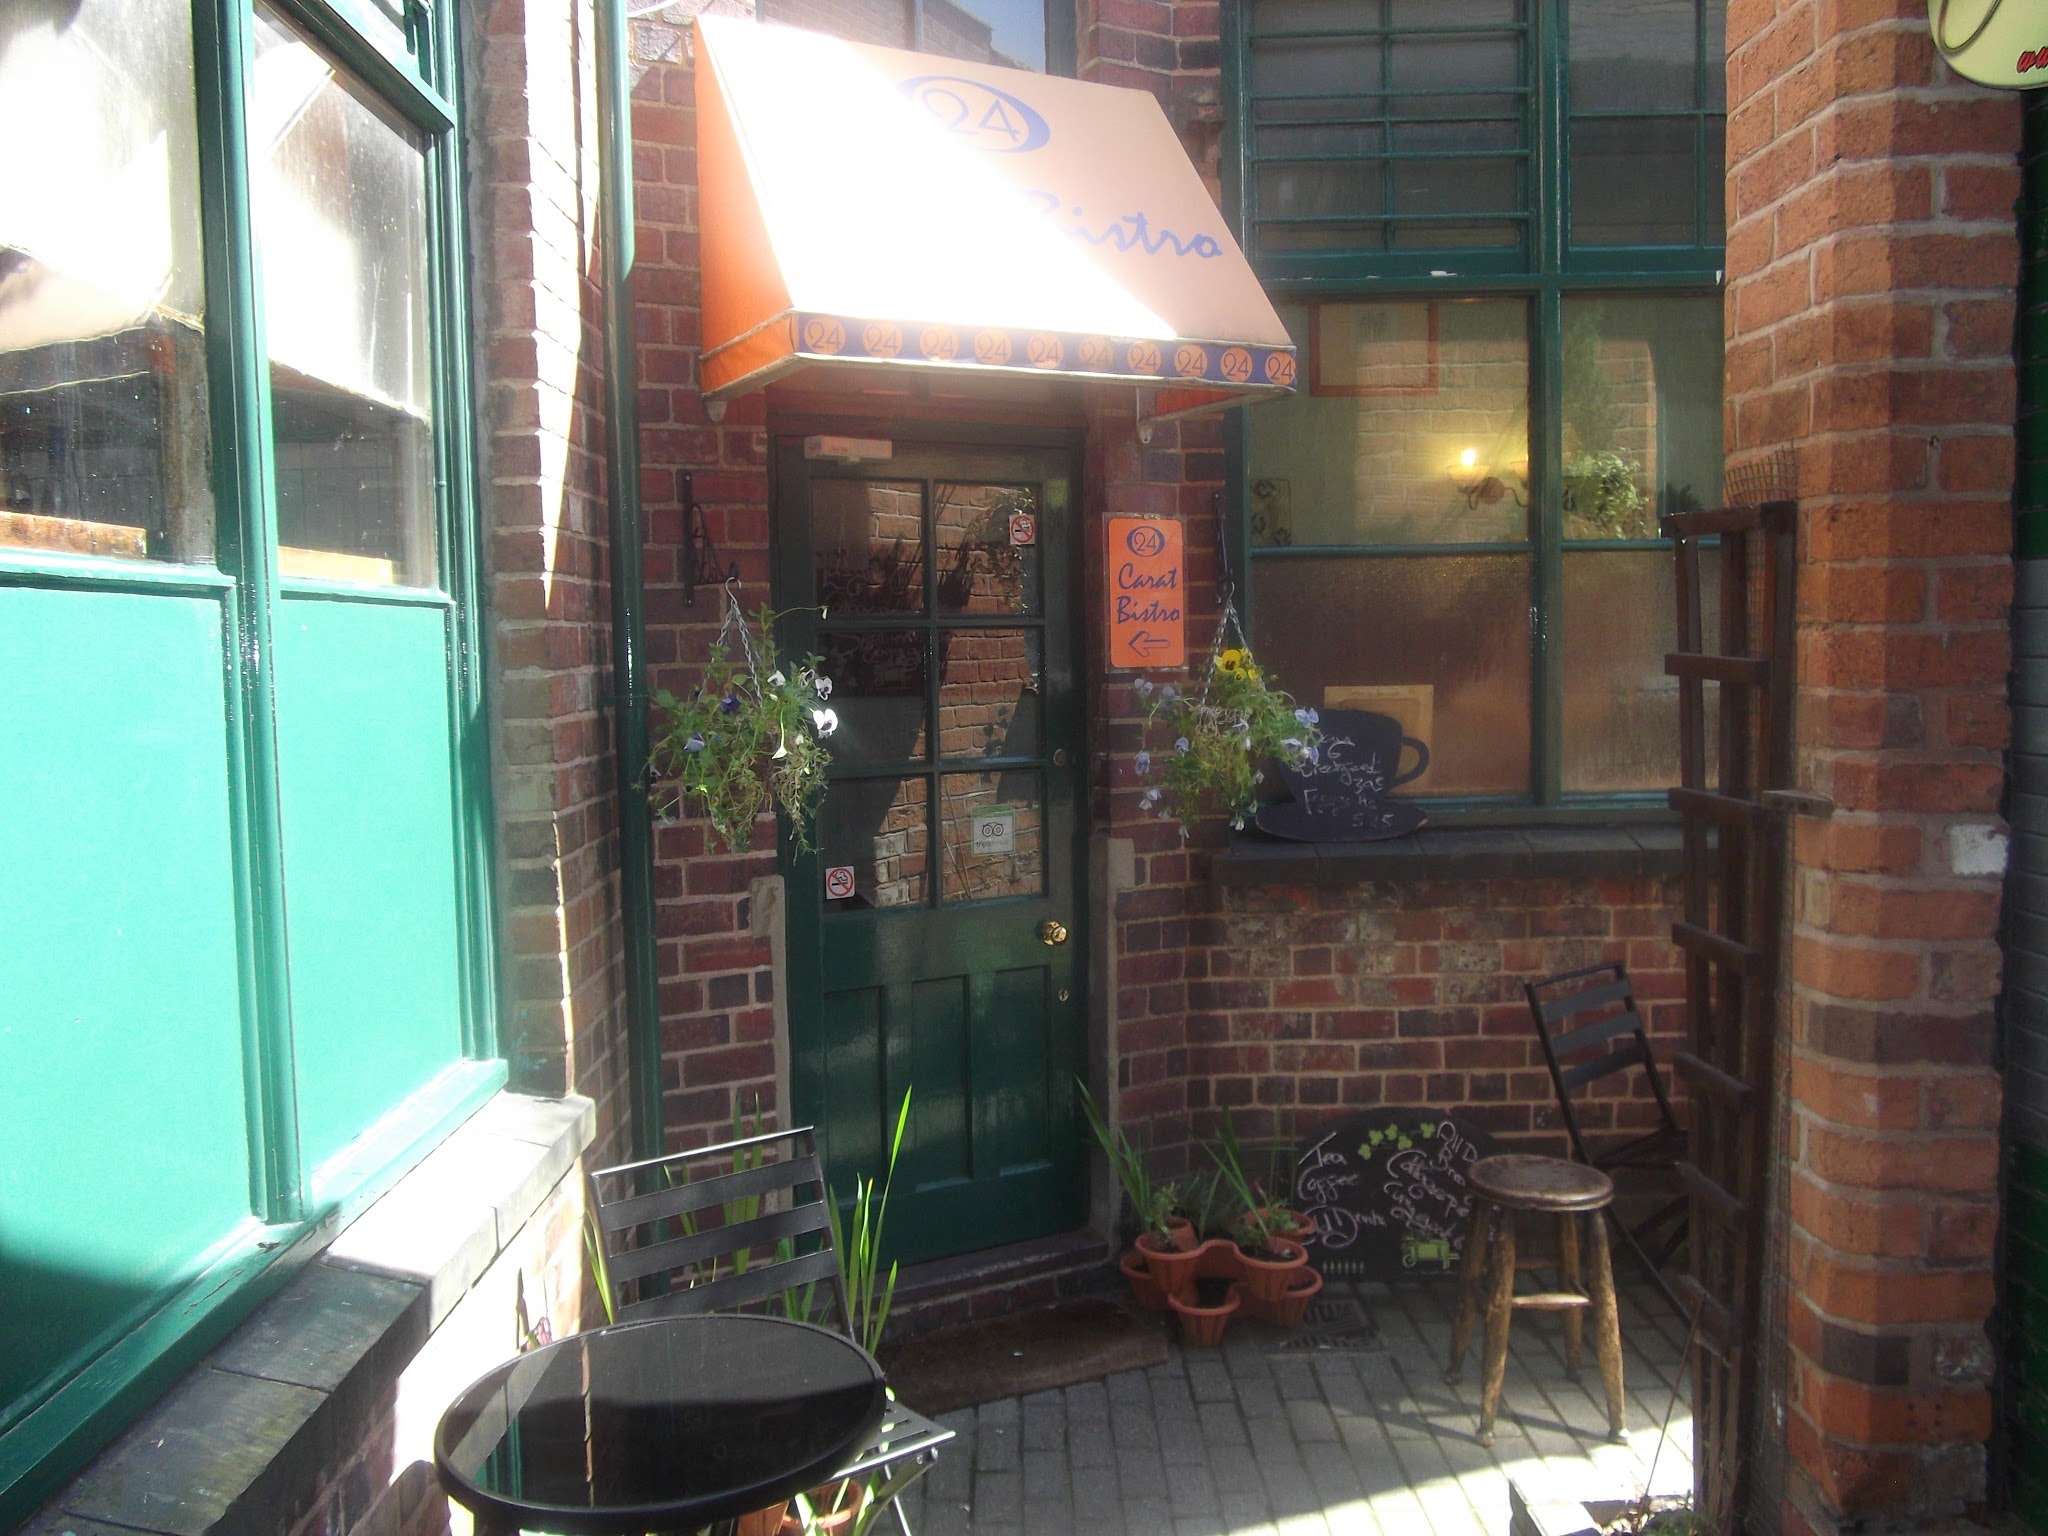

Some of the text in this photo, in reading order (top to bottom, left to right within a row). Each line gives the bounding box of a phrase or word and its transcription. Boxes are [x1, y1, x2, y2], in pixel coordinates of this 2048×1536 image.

[921, 87, 1021, 142] 24
[808, 322, 1293, 381] 24 24 24 24 24 24 24 24 24 24
[1134, 531, 1158, 552] 24
[1118, 562, 1178, 590] Carat
[1116, 595, 1181, 624] Bistro
[1297, 1131, 1348, 1168] Tea
